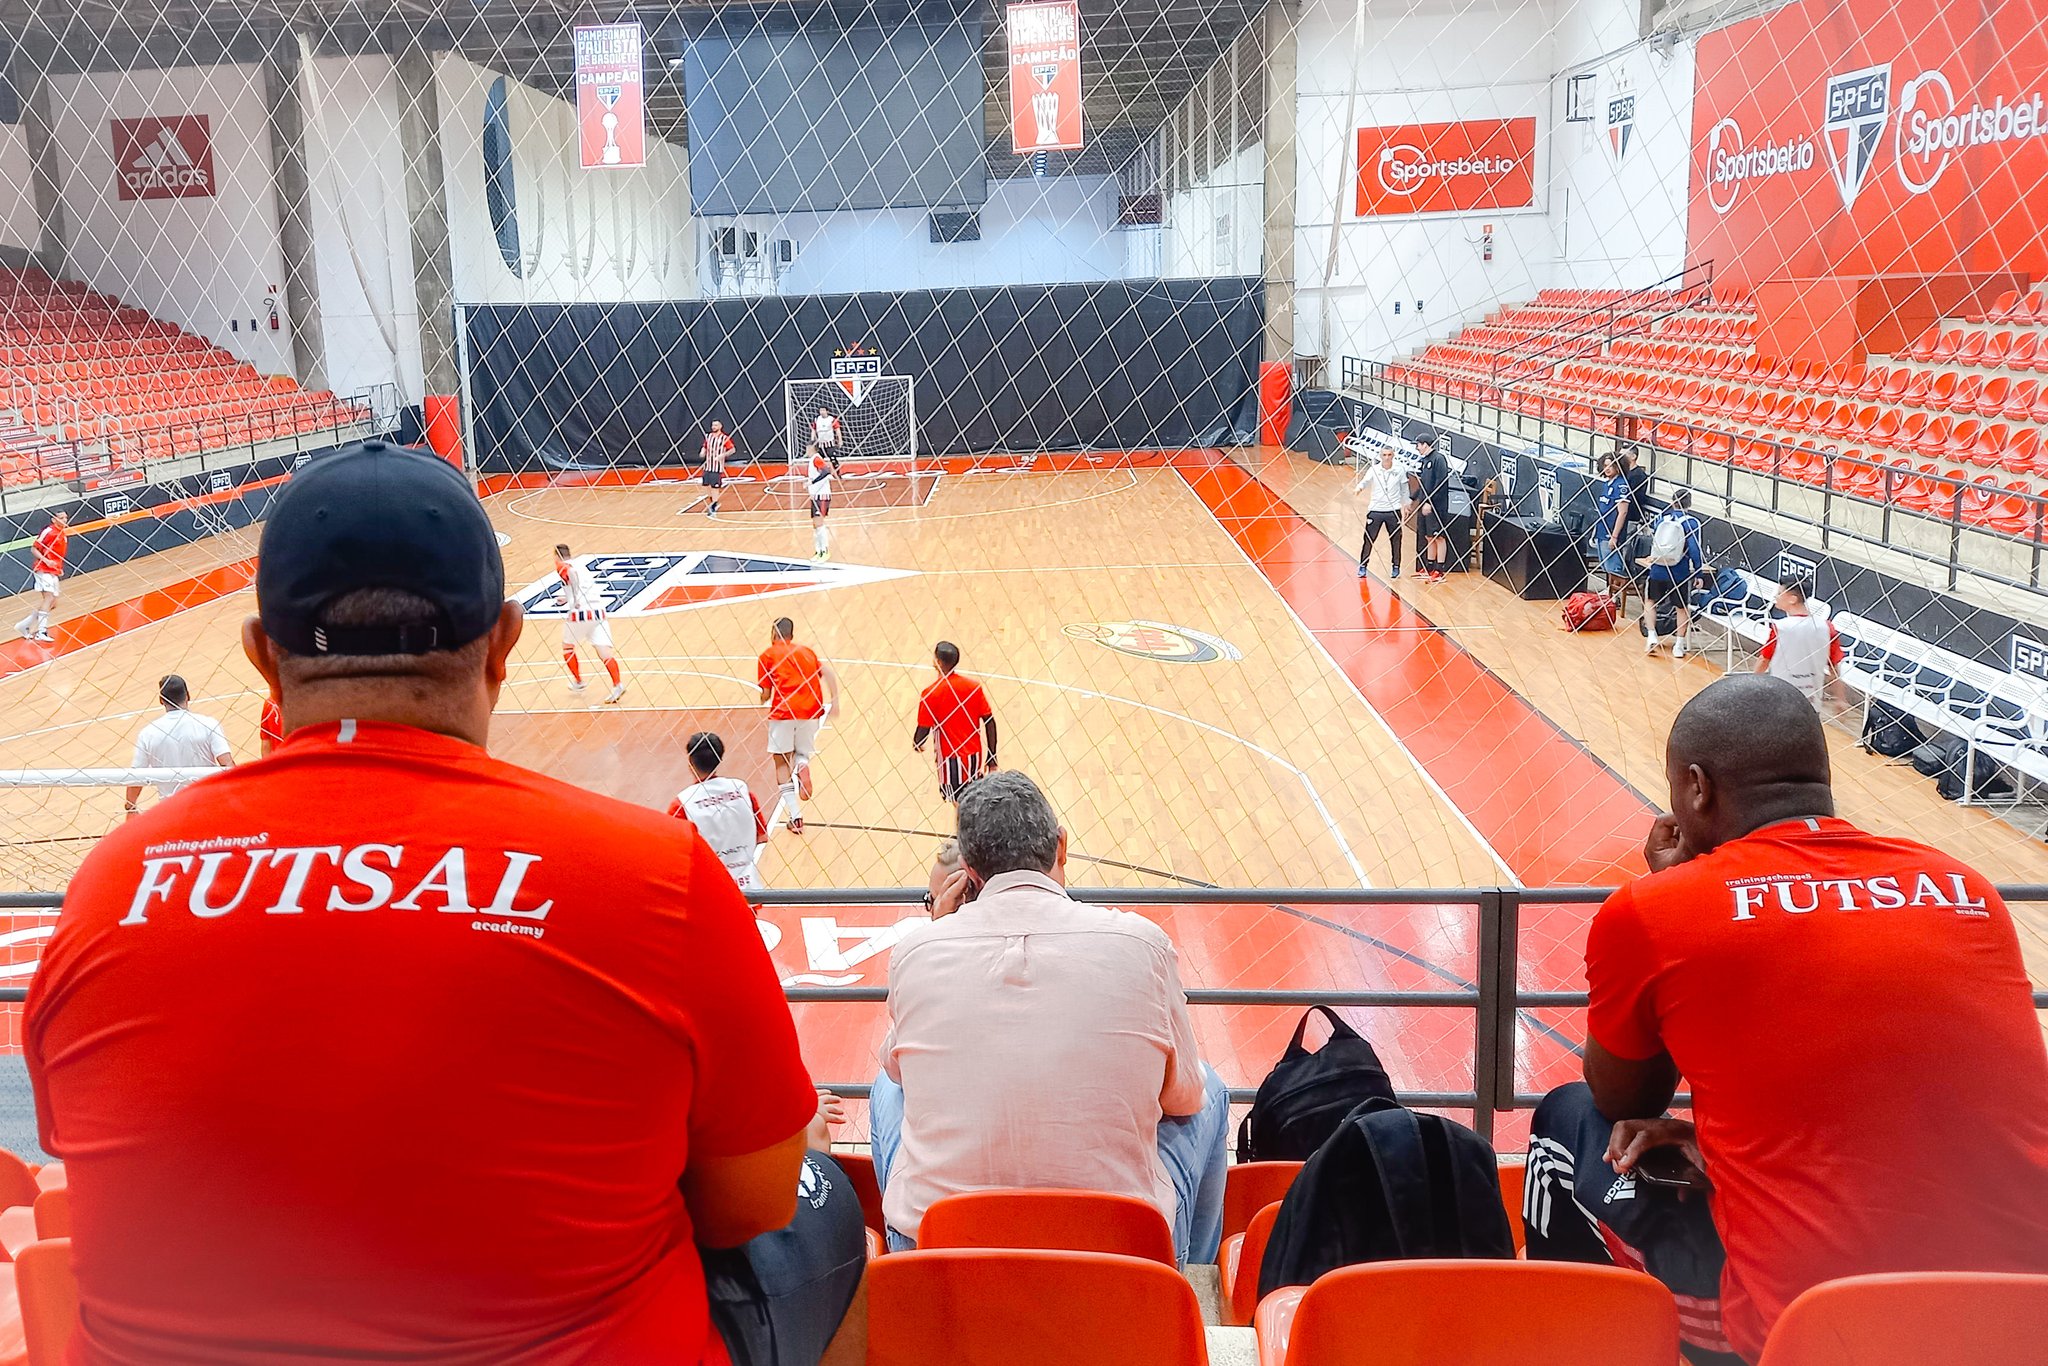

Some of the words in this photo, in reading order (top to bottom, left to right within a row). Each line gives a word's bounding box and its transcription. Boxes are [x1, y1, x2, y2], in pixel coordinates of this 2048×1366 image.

[577, 27, 637, 41] CAMPEONATO
[578, 39, 638, 55] PAULISTA
[1012, 46, 1076, 65] CAMPEÃO
[579, 54, 590, 66] DE
[591, 52, 638, 65] BASQUETE
[580, 69, 639, 85] CAMPEÃO
[1831, 79, 1885, 117] SPFC
[1609, 98, 1635, 122] SPFC
[1390, 154, 1514, 183] Sportsbet.io
[1715, 133, 1814, 190] Sportsbet.io
[125, 165, 208, 189] adidas
[835, 361, 876, 374] SPFC
[213, 475, 231, 489] SPFC
[106, 501, 128, 514] SPFC
[118, 843, 554, 927] FUTSAL
[1729, 873, 1986, 921] FUTSAL
[1955, 908, 1990, 919] academy
[470, 919, 545, 940] academy
